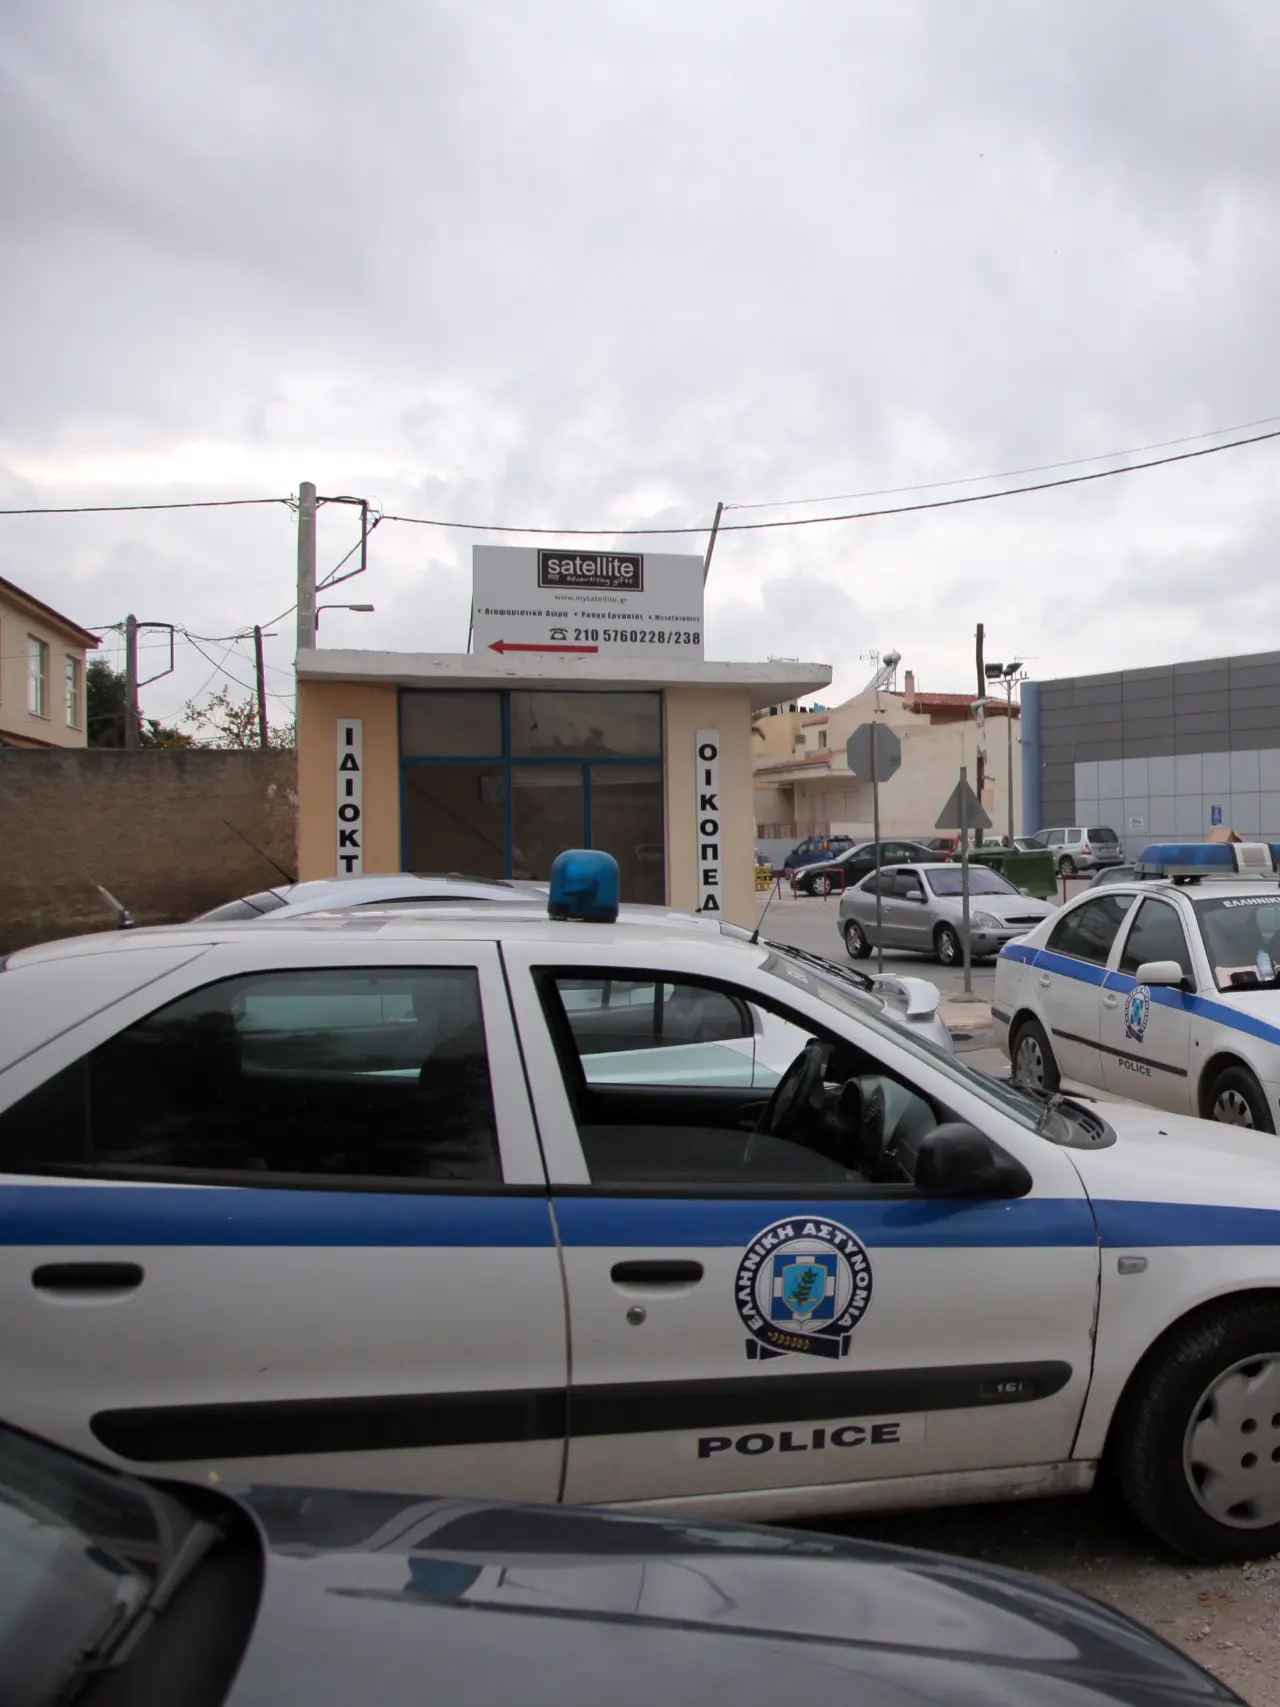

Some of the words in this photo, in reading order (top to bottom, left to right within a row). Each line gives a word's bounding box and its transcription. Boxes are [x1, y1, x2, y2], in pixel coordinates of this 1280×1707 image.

[547, 556, 634, 577] satellite
[554, 594, 627, 605] www.mysatellite.gr
[574, 628, 599, 641] 210
[603, 629, 700, 645] 5760228/238
[698, 743, 720, 911] ΟΙΚΟΠΕΔ
[1118, 1058, 1152, 1078] POLICE
[738, 1224, 795, 1331] ΕΛΛΗΝΙΚΗ
[802, 1222, 869, 1327] ΑΣΤΥΝΟΜΙΑ
[697, 1423, 901, 1459] POLICE
